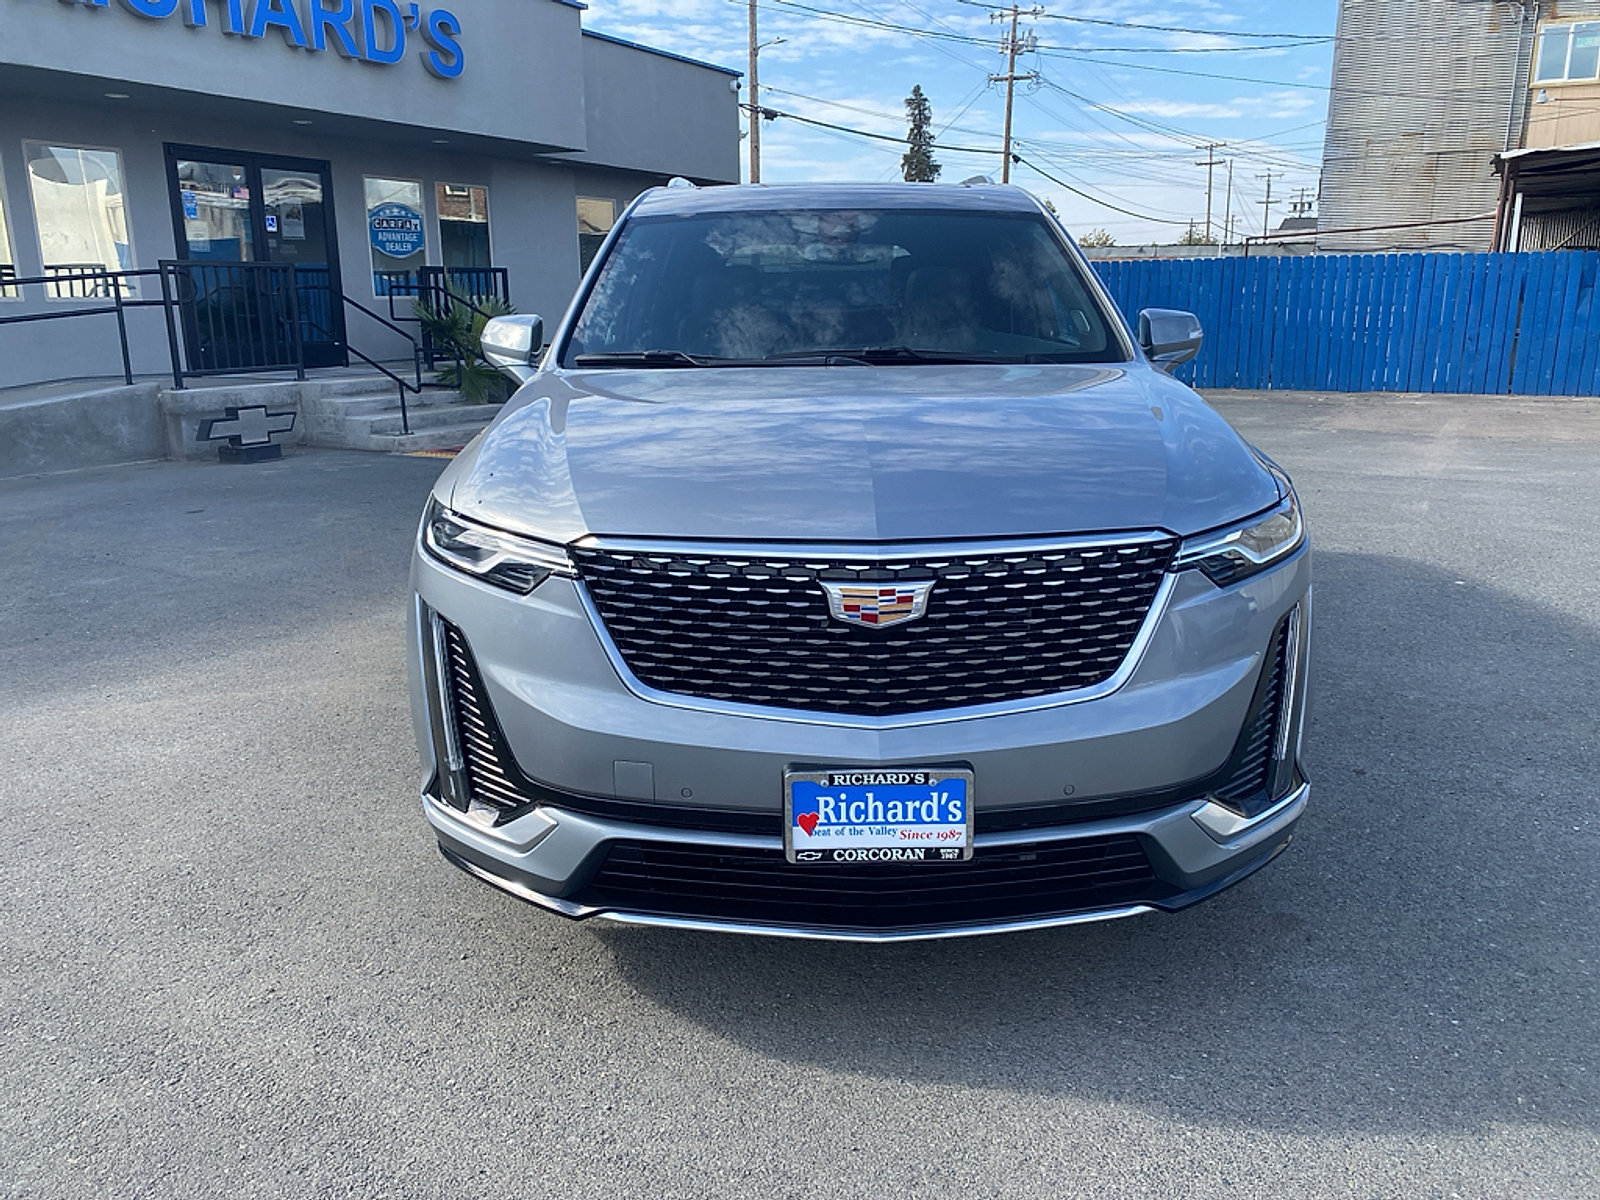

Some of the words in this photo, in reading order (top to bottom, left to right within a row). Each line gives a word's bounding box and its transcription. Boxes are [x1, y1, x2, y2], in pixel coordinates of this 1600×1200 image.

[60, 0, 465, 79] ARD'S
[373, 218, 420, 230] CARFAX
[833, 773, 925, 786] RICHARD'S
[816, 792, 962, 823] Richard's
[835, 826, 846, 836] of
[849, 826, 864, 836] the
[868, 826, 898, 837] Valley
[899, 829, 933, 840] Since
[936, 829, 962, 841] 1987
[833, 848, 926, 861] CORCORAN
